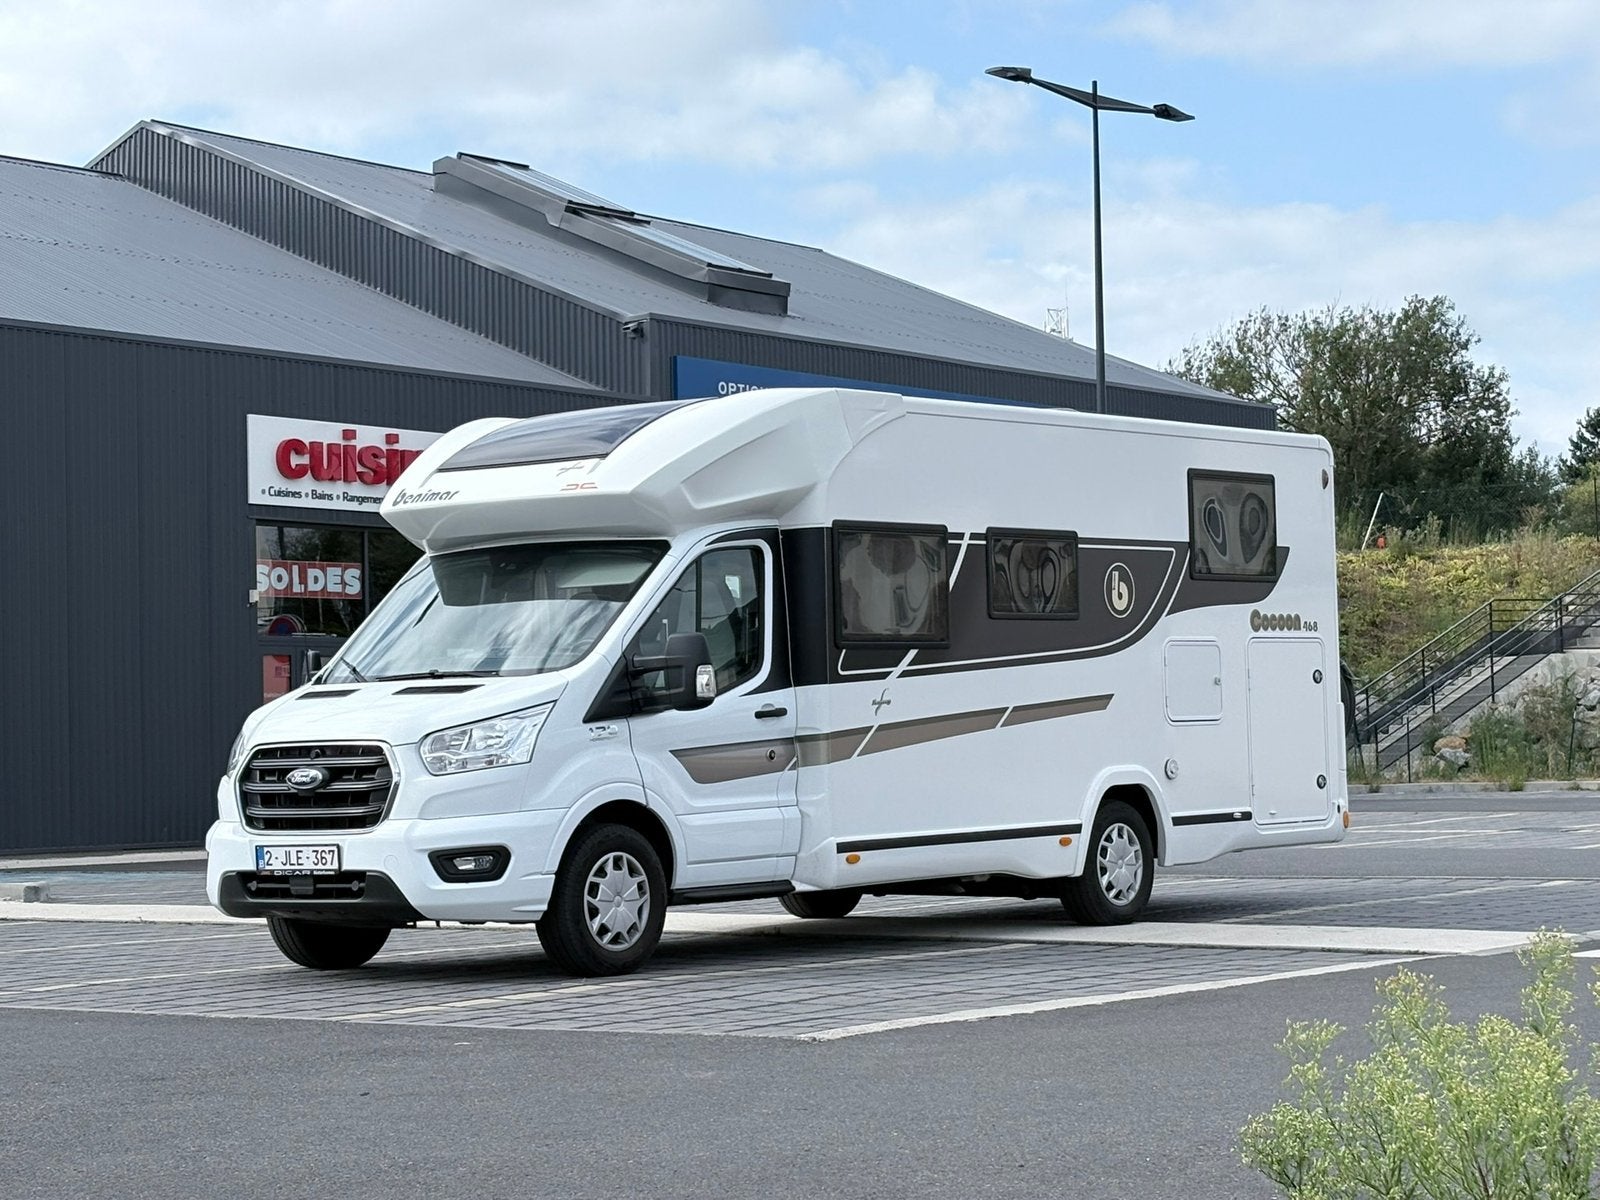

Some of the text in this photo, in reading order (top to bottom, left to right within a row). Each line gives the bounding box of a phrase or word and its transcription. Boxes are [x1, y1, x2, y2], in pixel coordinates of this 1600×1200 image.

[718, 381, 768, 395] OPTI
[268, 486, 302, 499] Cuisines
[311, 489, 334, 501] Bains
[392, 488, 460, 507] benimar
[256, 564, 361, 595] SOLDES
[1249, 608, 1319, 633] Cocoon 468
[265, 849, 336, 867] 2-JLE-367
